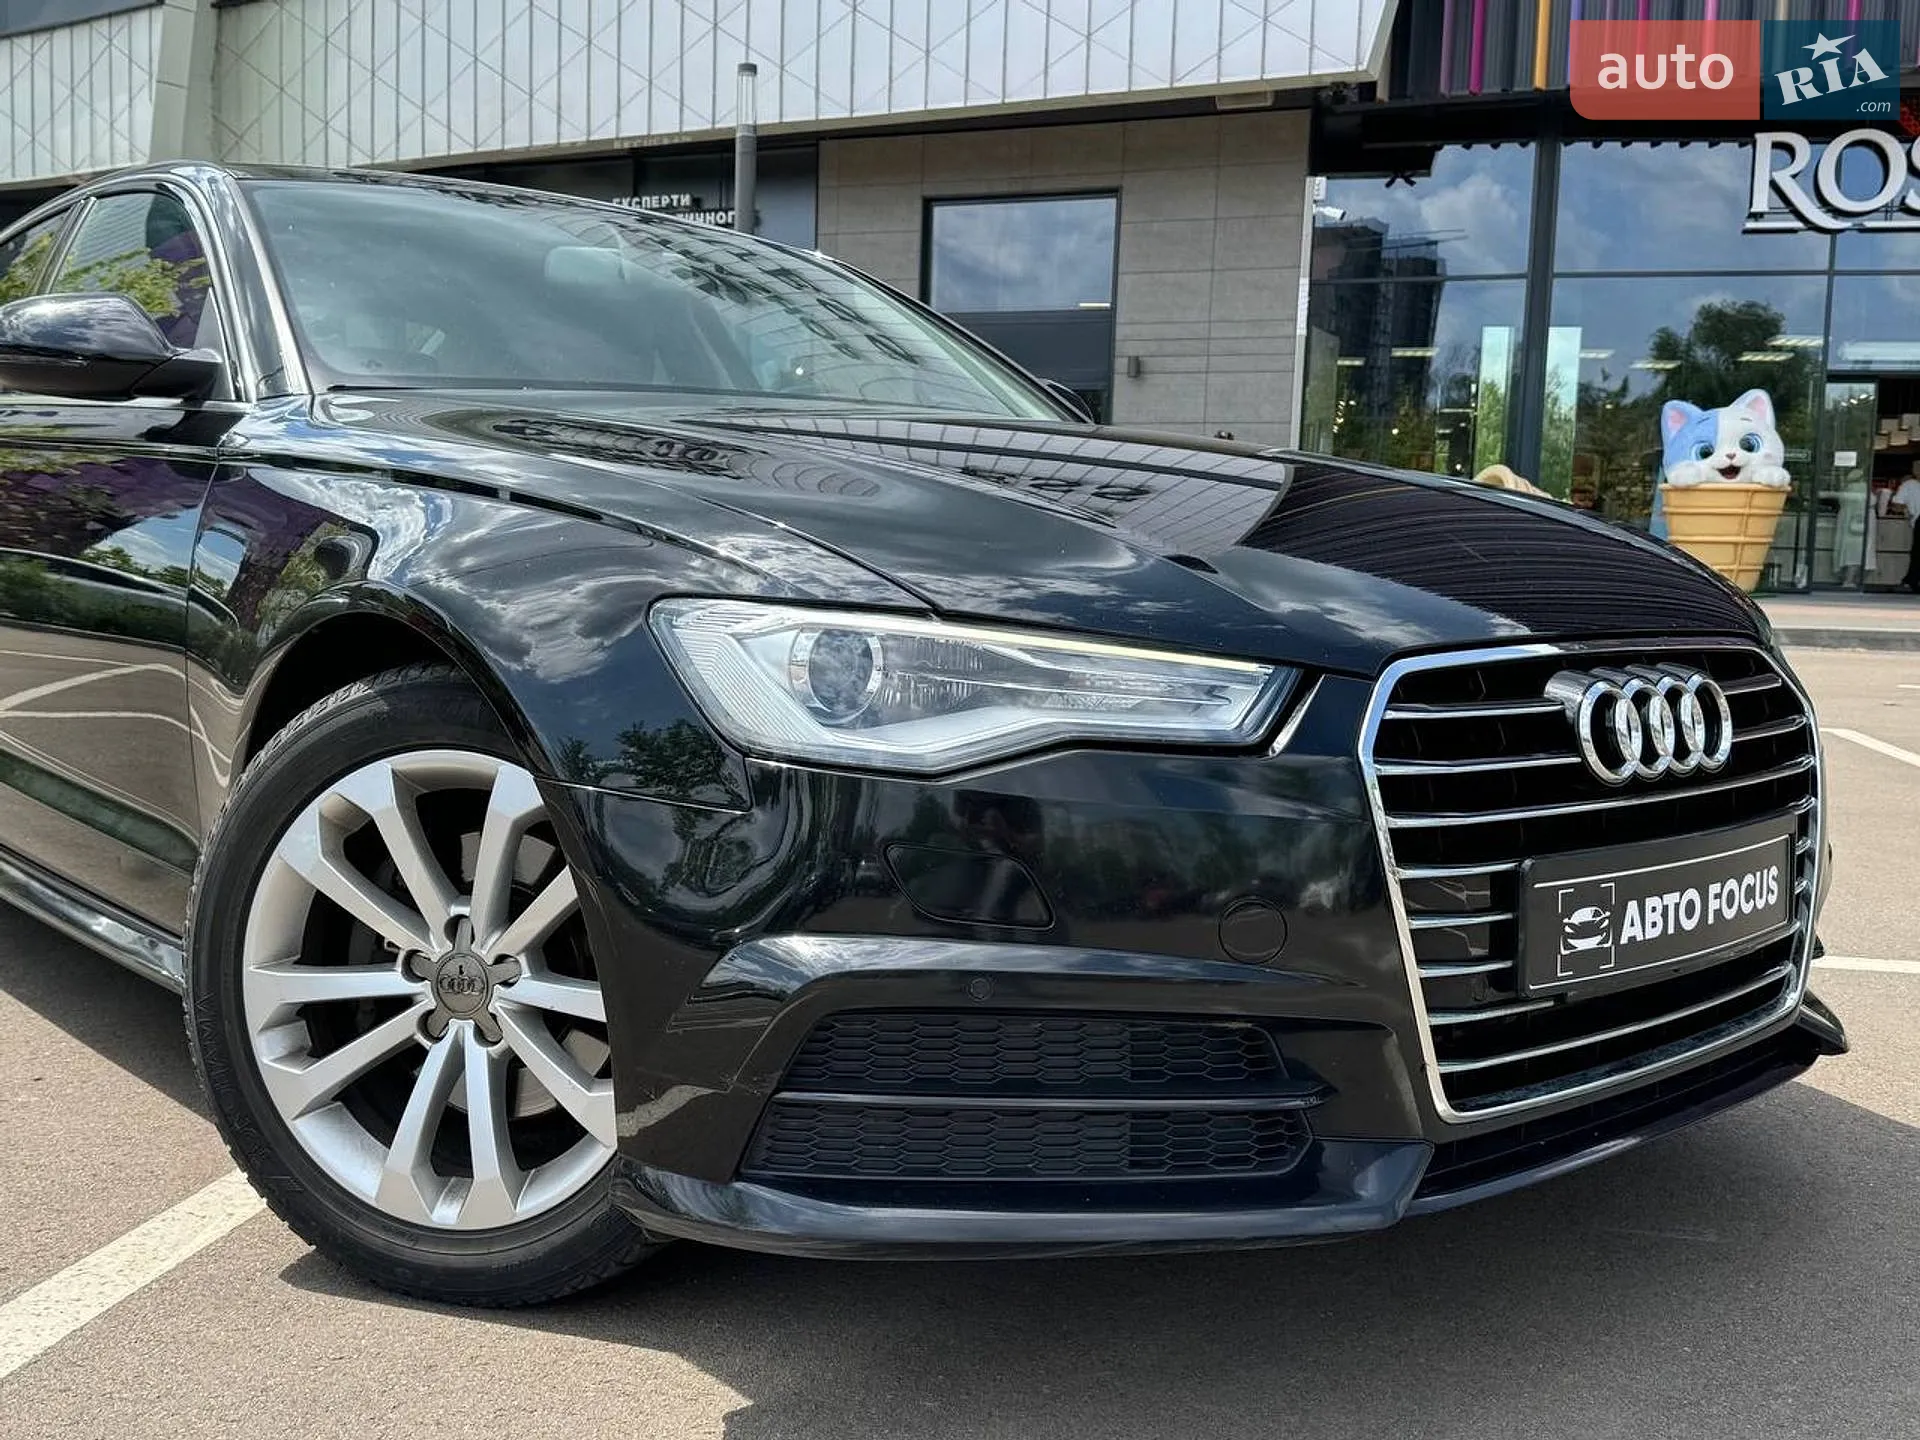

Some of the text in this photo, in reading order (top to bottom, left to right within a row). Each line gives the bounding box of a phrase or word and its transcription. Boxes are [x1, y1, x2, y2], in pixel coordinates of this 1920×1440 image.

[612, 193, 691, 209] ЕКСПЕРТИ
[1620, 865, 1778, 945] АВТО FOCUS
